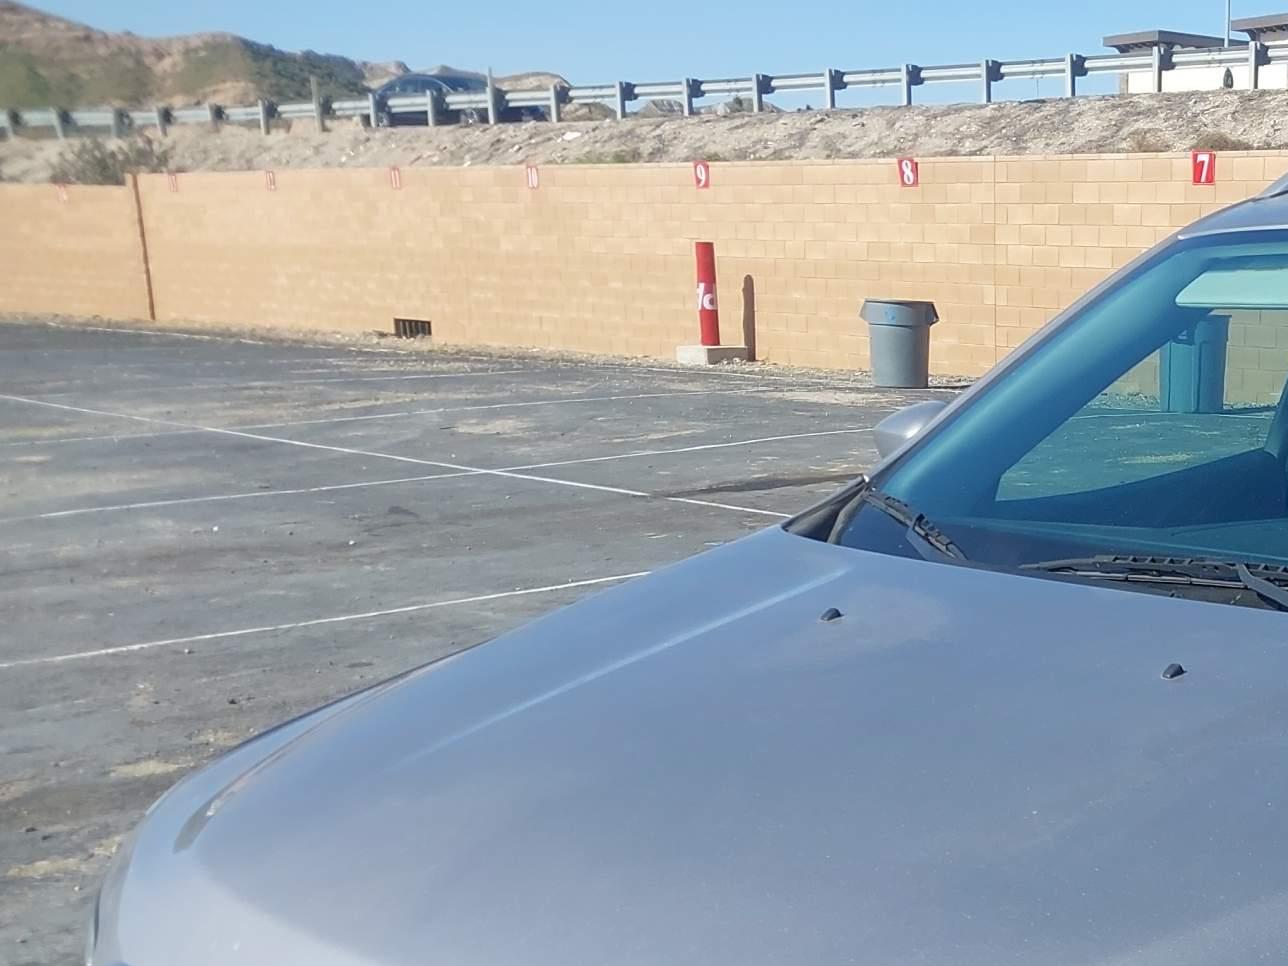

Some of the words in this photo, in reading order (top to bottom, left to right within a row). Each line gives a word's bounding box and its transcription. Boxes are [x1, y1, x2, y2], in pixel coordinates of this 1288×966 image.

[696, 164, 706, 187] 9
[901, 159, 914, 185] 8
[1196, 153, 1210, 183] 7
